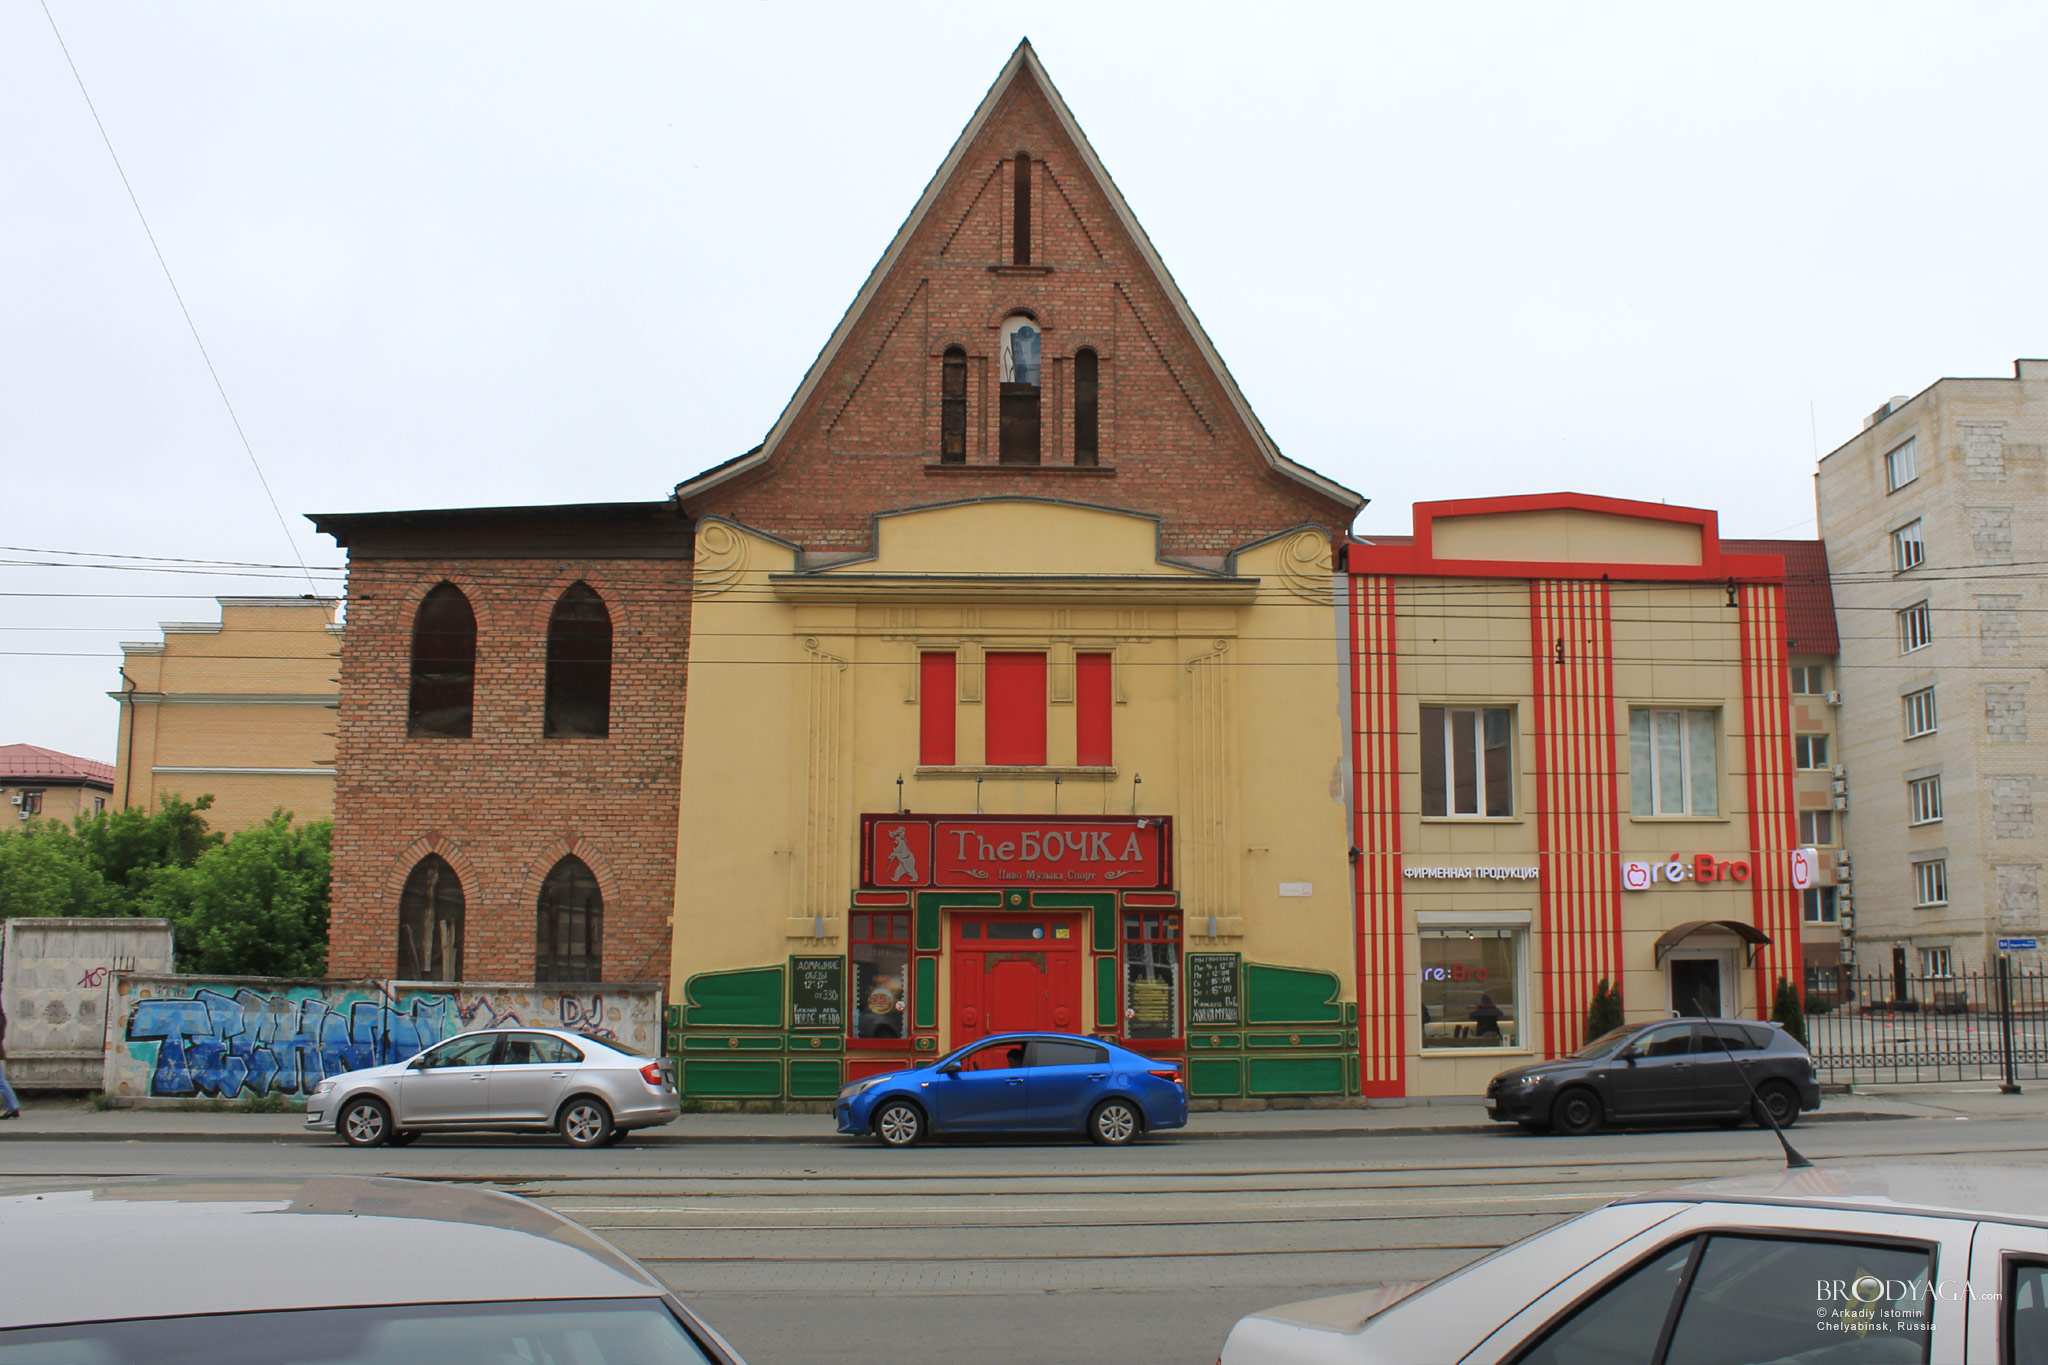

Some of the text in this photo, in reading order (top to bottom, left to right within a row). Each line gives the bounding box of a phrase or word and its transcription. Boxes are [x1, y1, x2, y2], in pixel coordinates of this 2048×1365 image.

[949, 830, 1144, 862] The БОЧКА
[998, 869, 1097, 882] Пиво Музыка Спорт
[1403, 866, 1539, 880] ФИРМЕННАЯ ПРОДУКЦИЯ
